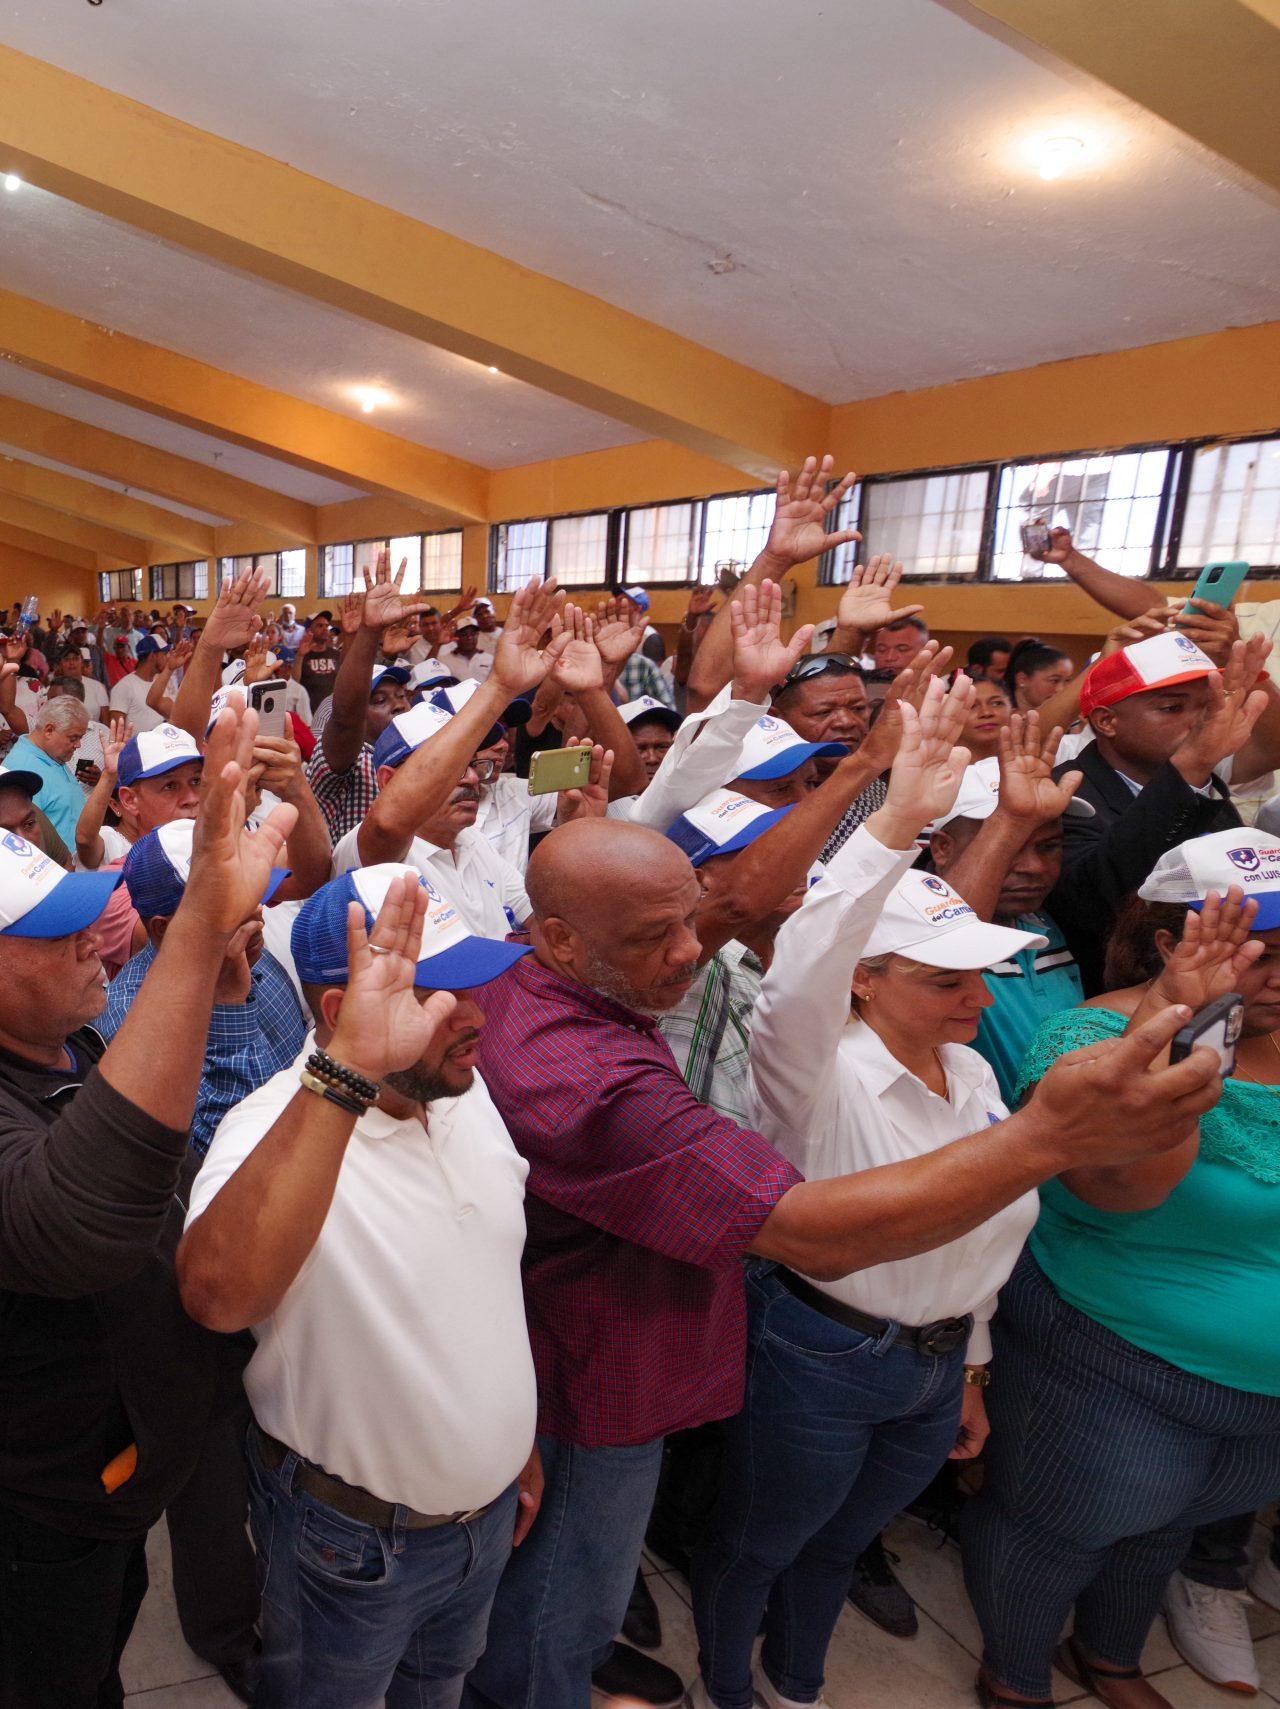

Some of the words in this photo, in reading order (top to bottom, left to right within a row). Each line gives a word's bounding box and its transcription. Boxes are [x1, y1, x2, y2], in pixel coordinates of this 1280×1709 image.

[310, 658, 336, 671] USA
[1244, 873, 1262, 882] con
[1261, 870, 1280, 880] LUIS
[932, 913, 944, 922] del
